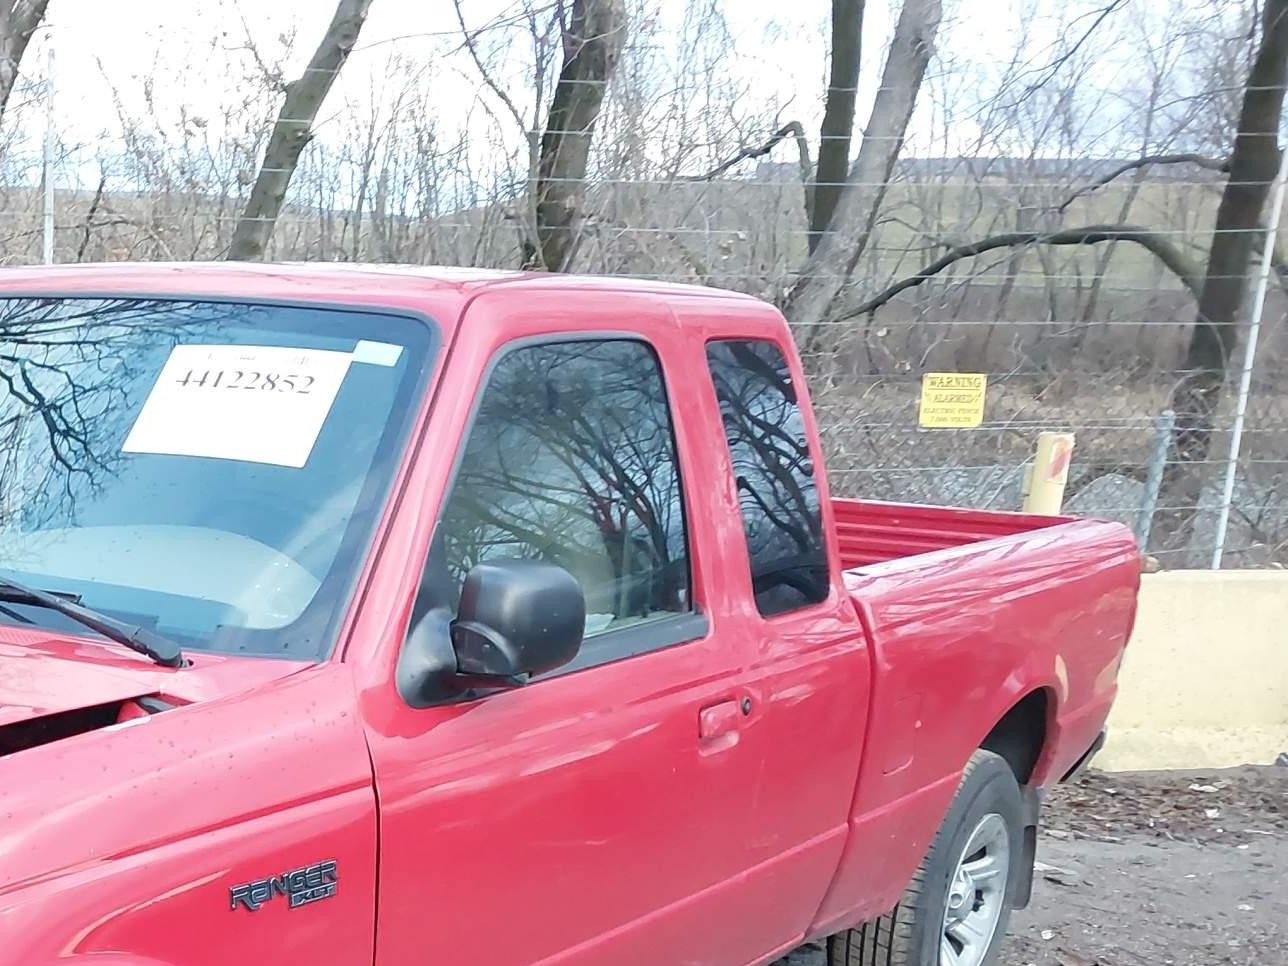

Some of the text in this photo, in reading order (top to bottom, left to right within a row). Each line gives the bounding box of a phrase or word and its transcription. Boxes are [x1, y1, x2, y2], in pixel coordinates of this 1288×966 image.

[175, 368, 316, 395] 44122852
[927, 376, 982, 388] WARNING
[230, 860, 337, 912] RANGER
[290, 882, 336, 908] XLT
